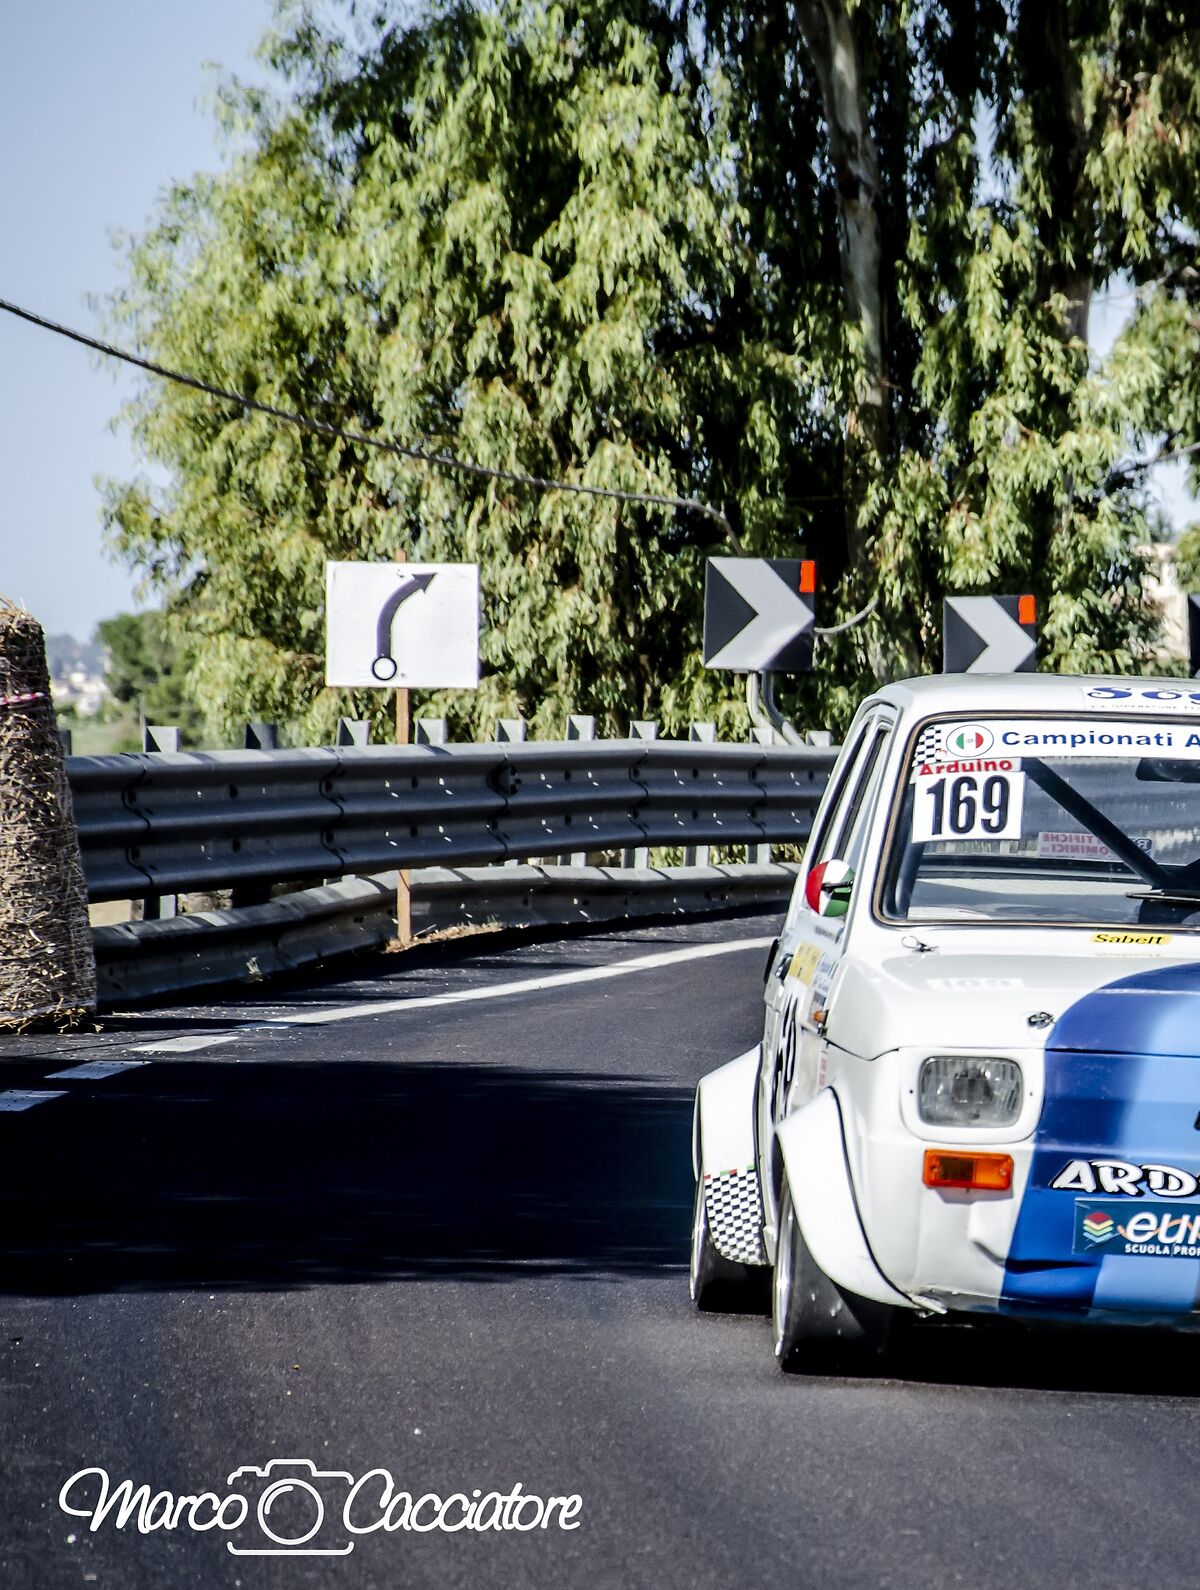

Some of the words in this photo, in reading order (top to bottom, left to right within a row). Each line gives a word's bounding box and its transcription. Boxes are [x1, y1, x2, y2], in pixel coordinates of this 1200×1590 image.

[1002, 731, 1173, 748] Campionati
[919, 758, 1013, 776] Arduino
[926, 775, 1010, 836] 169
[1094, 933, 1164, 946] Sabelt
[1124, 1243, 1170, 1256] SCUOLA
